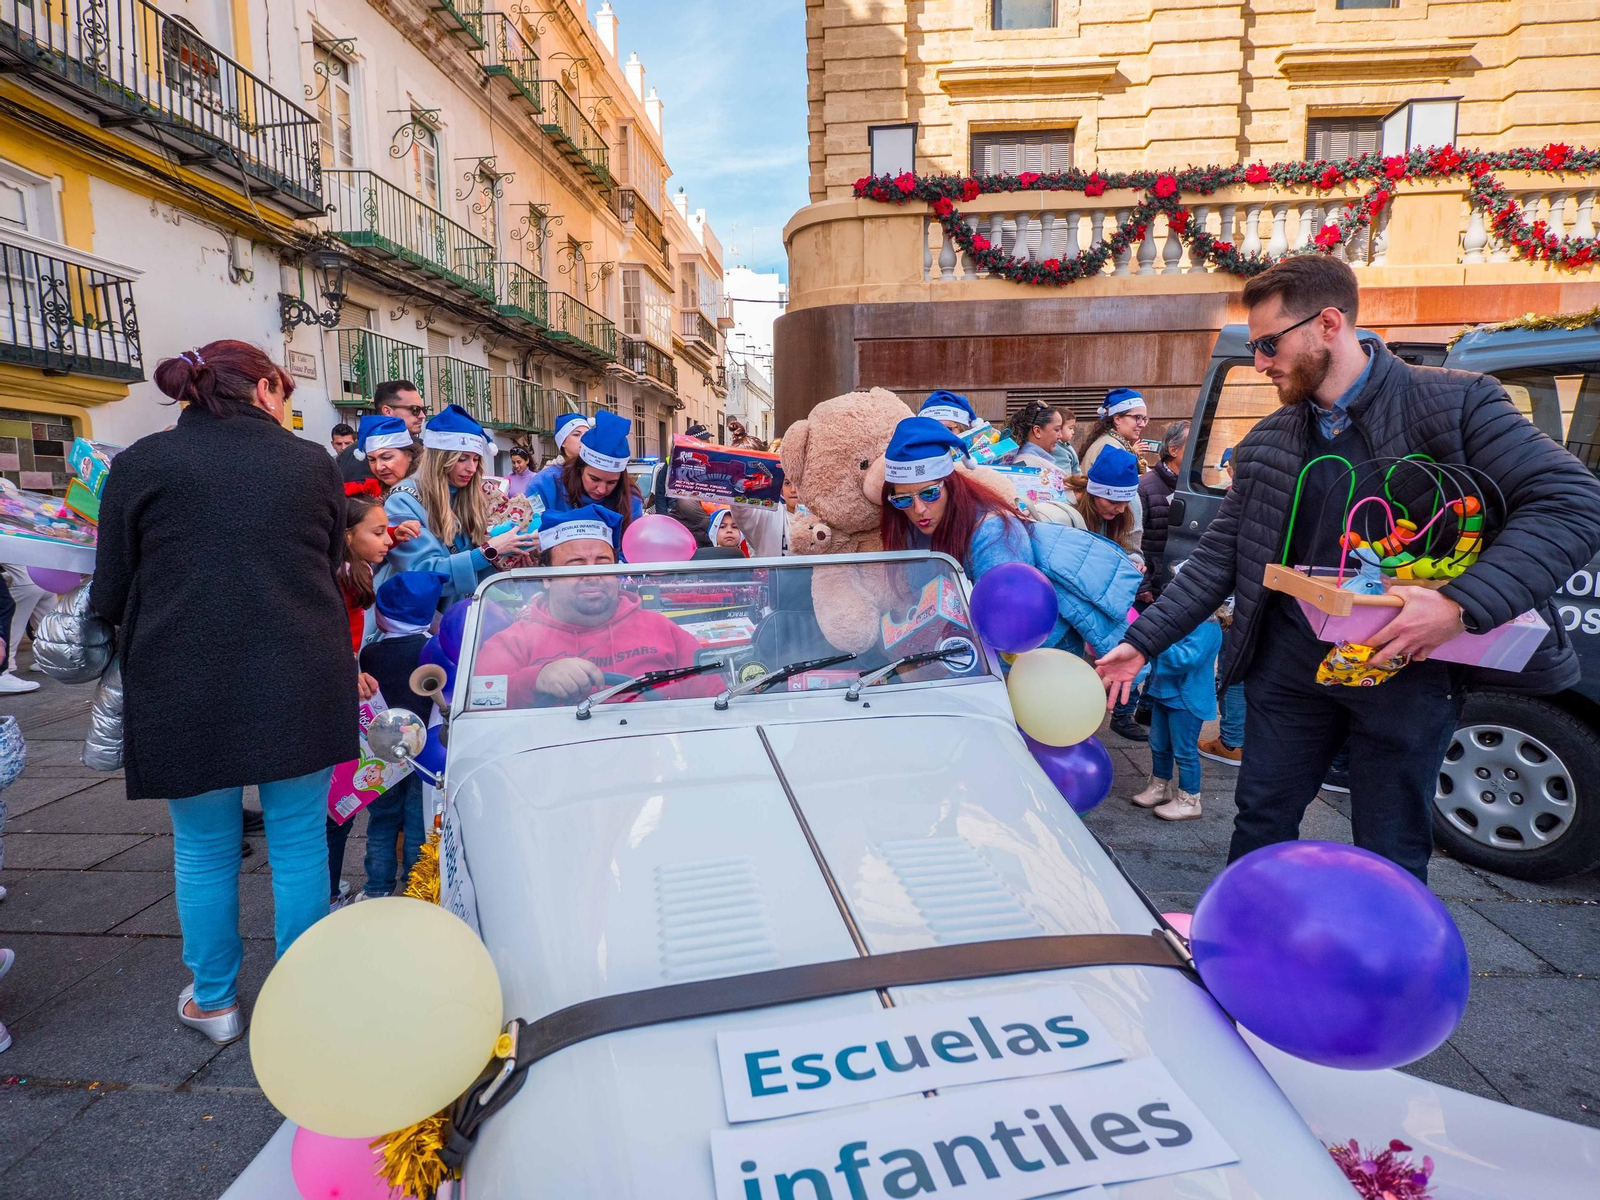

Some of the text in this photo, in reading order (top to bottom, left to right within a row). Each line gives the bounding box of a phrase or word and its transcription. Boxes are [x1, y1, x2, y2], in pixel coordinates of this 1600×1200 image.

[297, 355, 307, 363] Calle
[291, 363, 315, 375] Isaac Peral
[561, 524, 579, 532] ESCUELAS
[744, 1014, 1091, 1098] Escuelas
[740, 1101, 1194, 1200] infantiles
